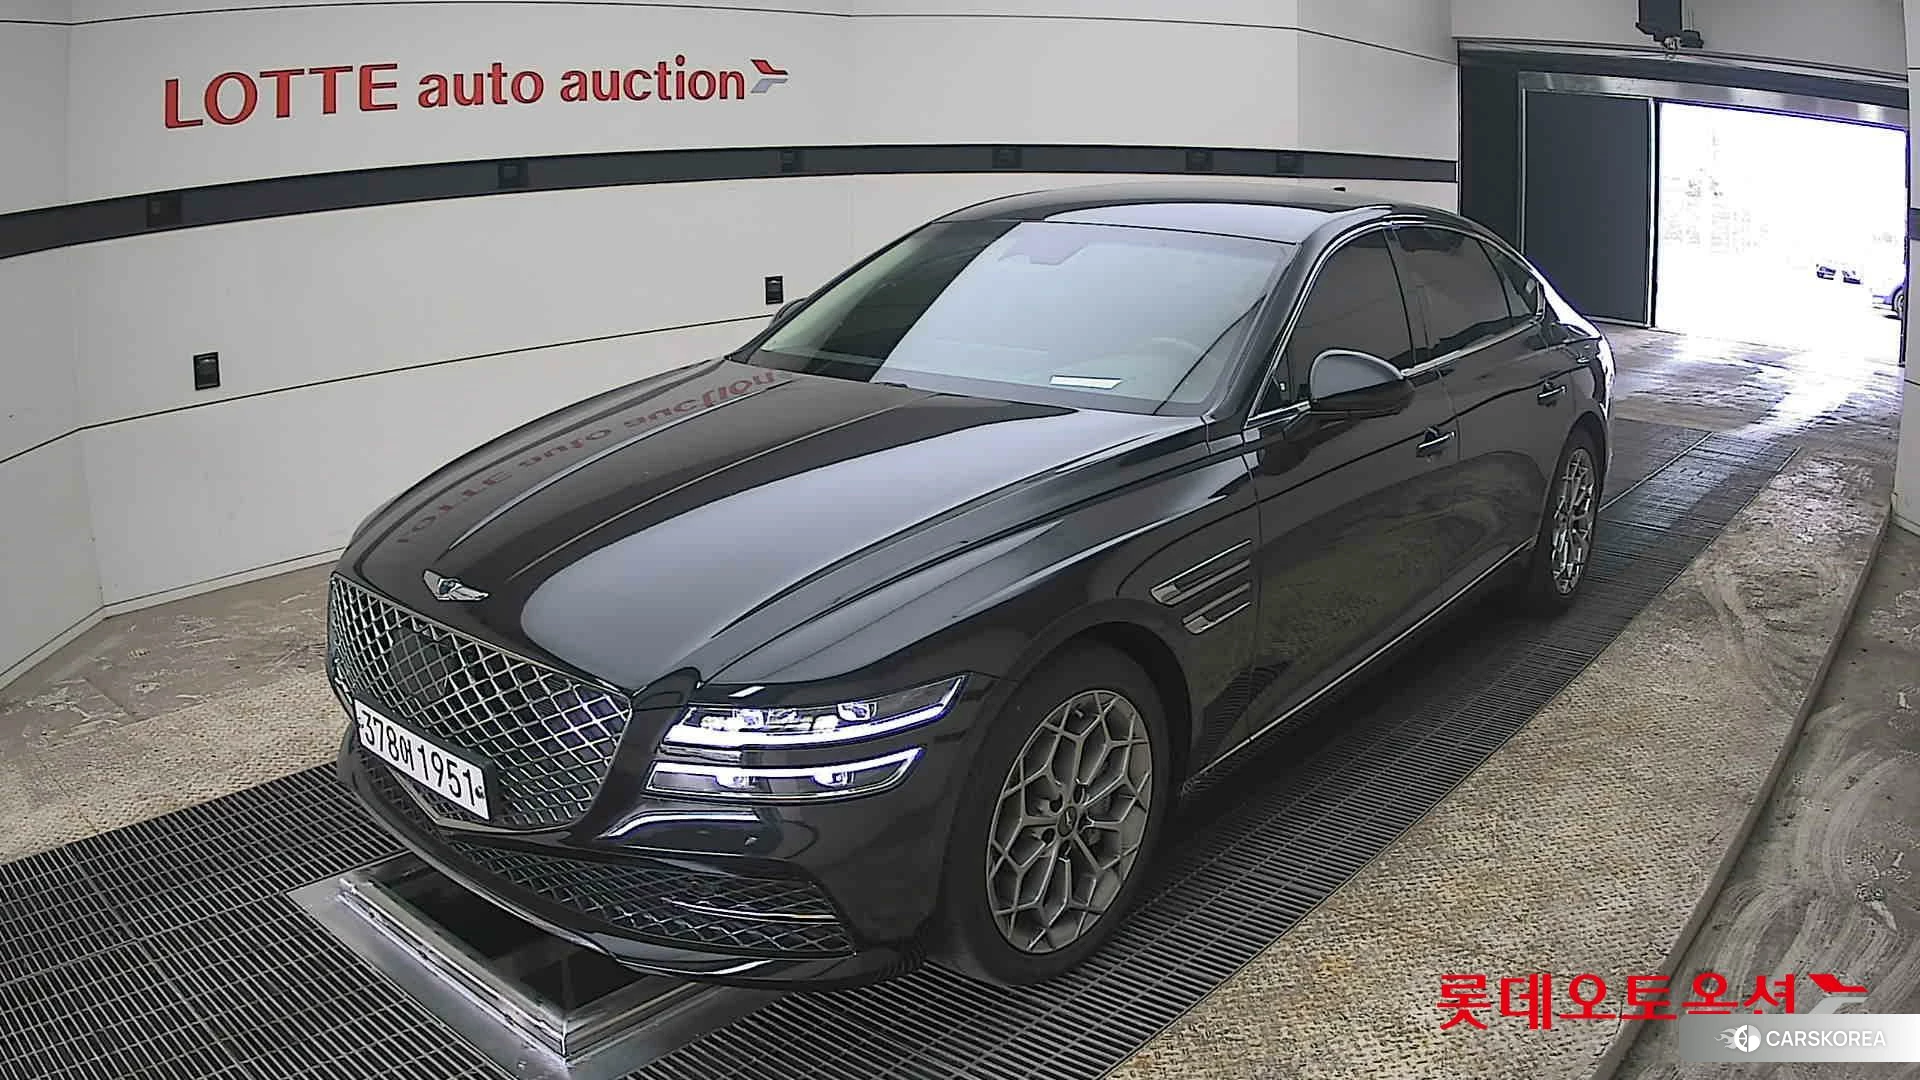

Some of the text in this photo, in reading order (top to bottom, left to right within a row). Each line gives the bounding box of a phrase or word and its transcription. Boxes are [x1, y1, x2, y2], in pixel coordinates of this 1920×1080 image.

[165, 55, 745, 128] LOTTE auto auction
